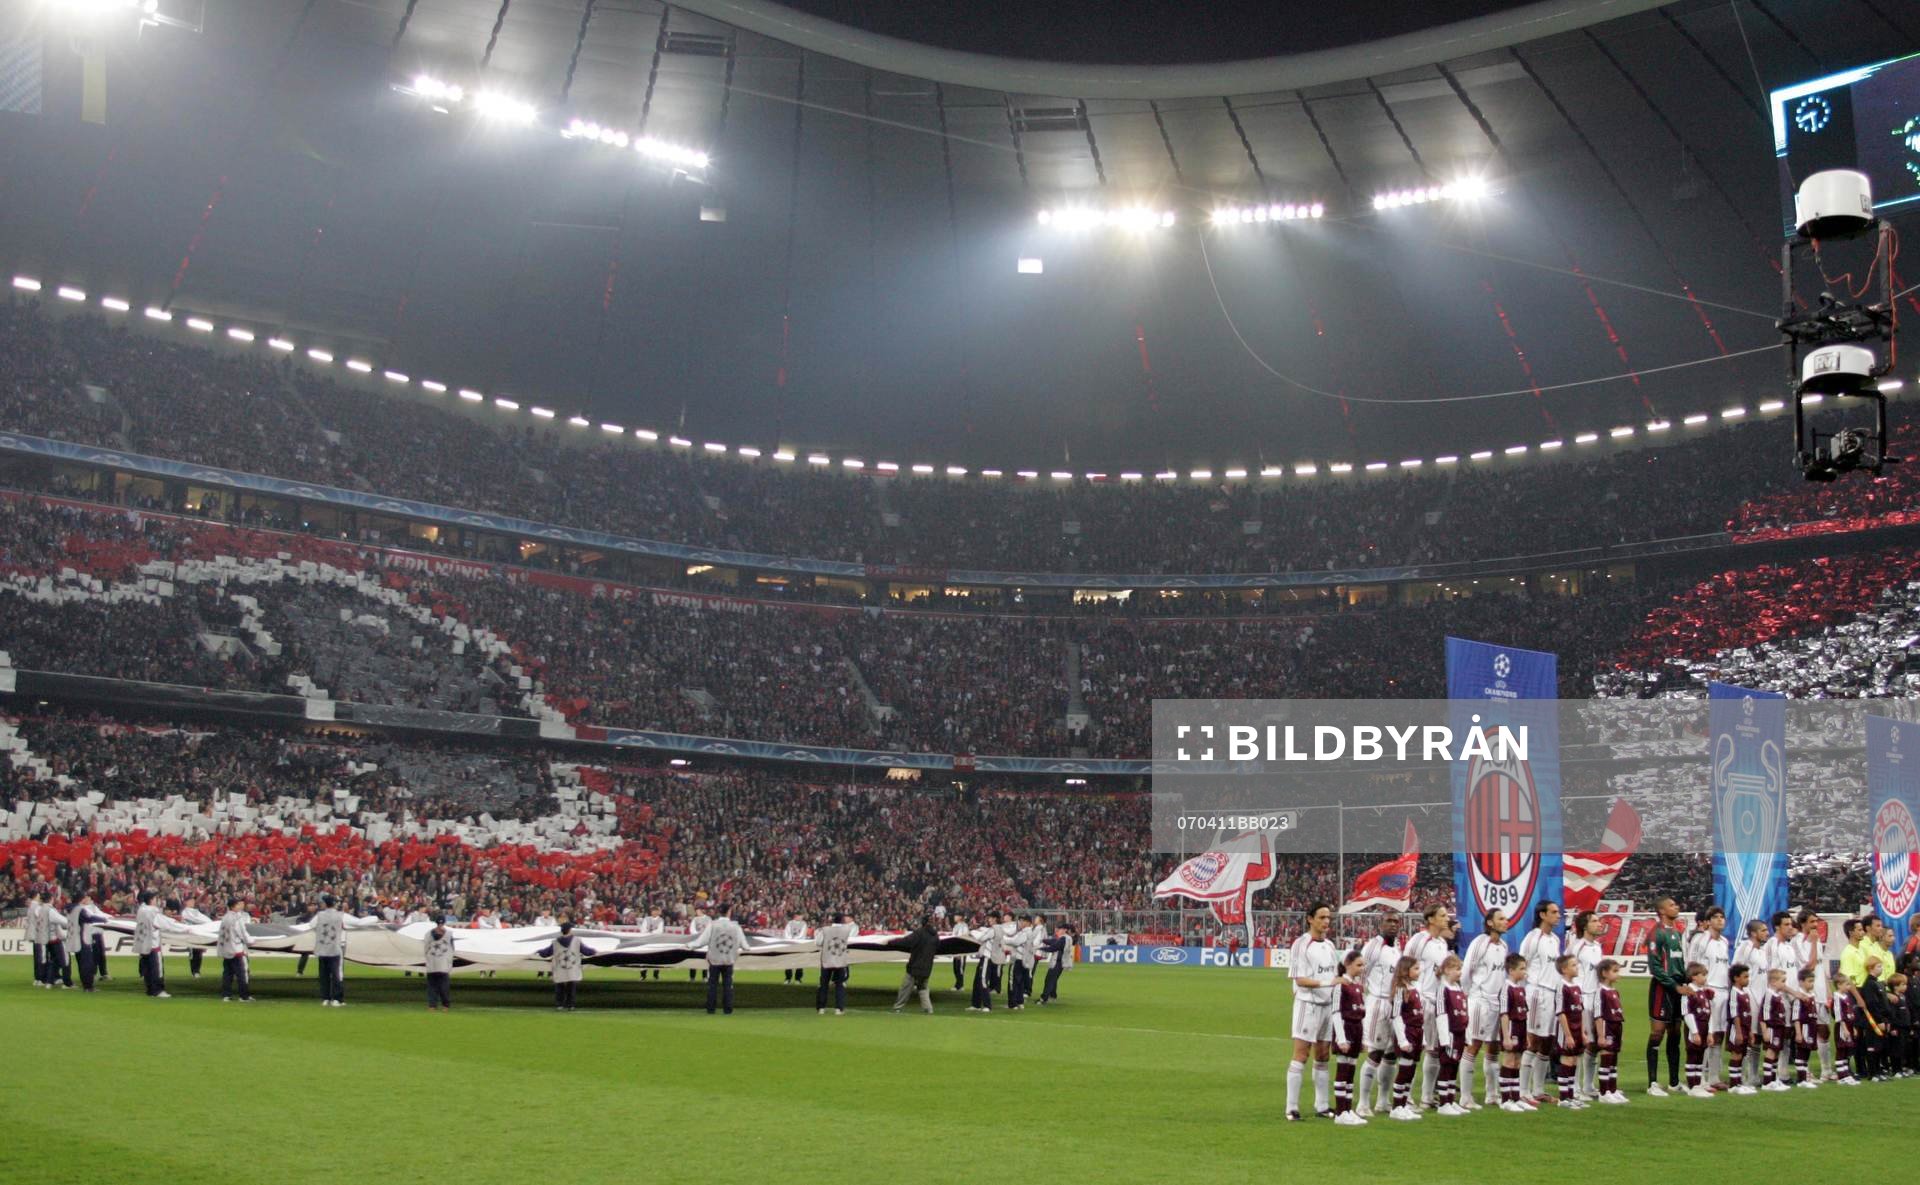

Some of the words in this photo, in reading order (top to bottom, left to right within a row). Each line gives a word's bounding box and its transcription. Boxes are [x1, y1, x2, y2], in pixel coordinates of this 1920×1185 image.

[1483, 883, 1519, 906] 1899
[1089, 944, 1138, 963] Ford
[1157, 947, 1181, 961] Ford
